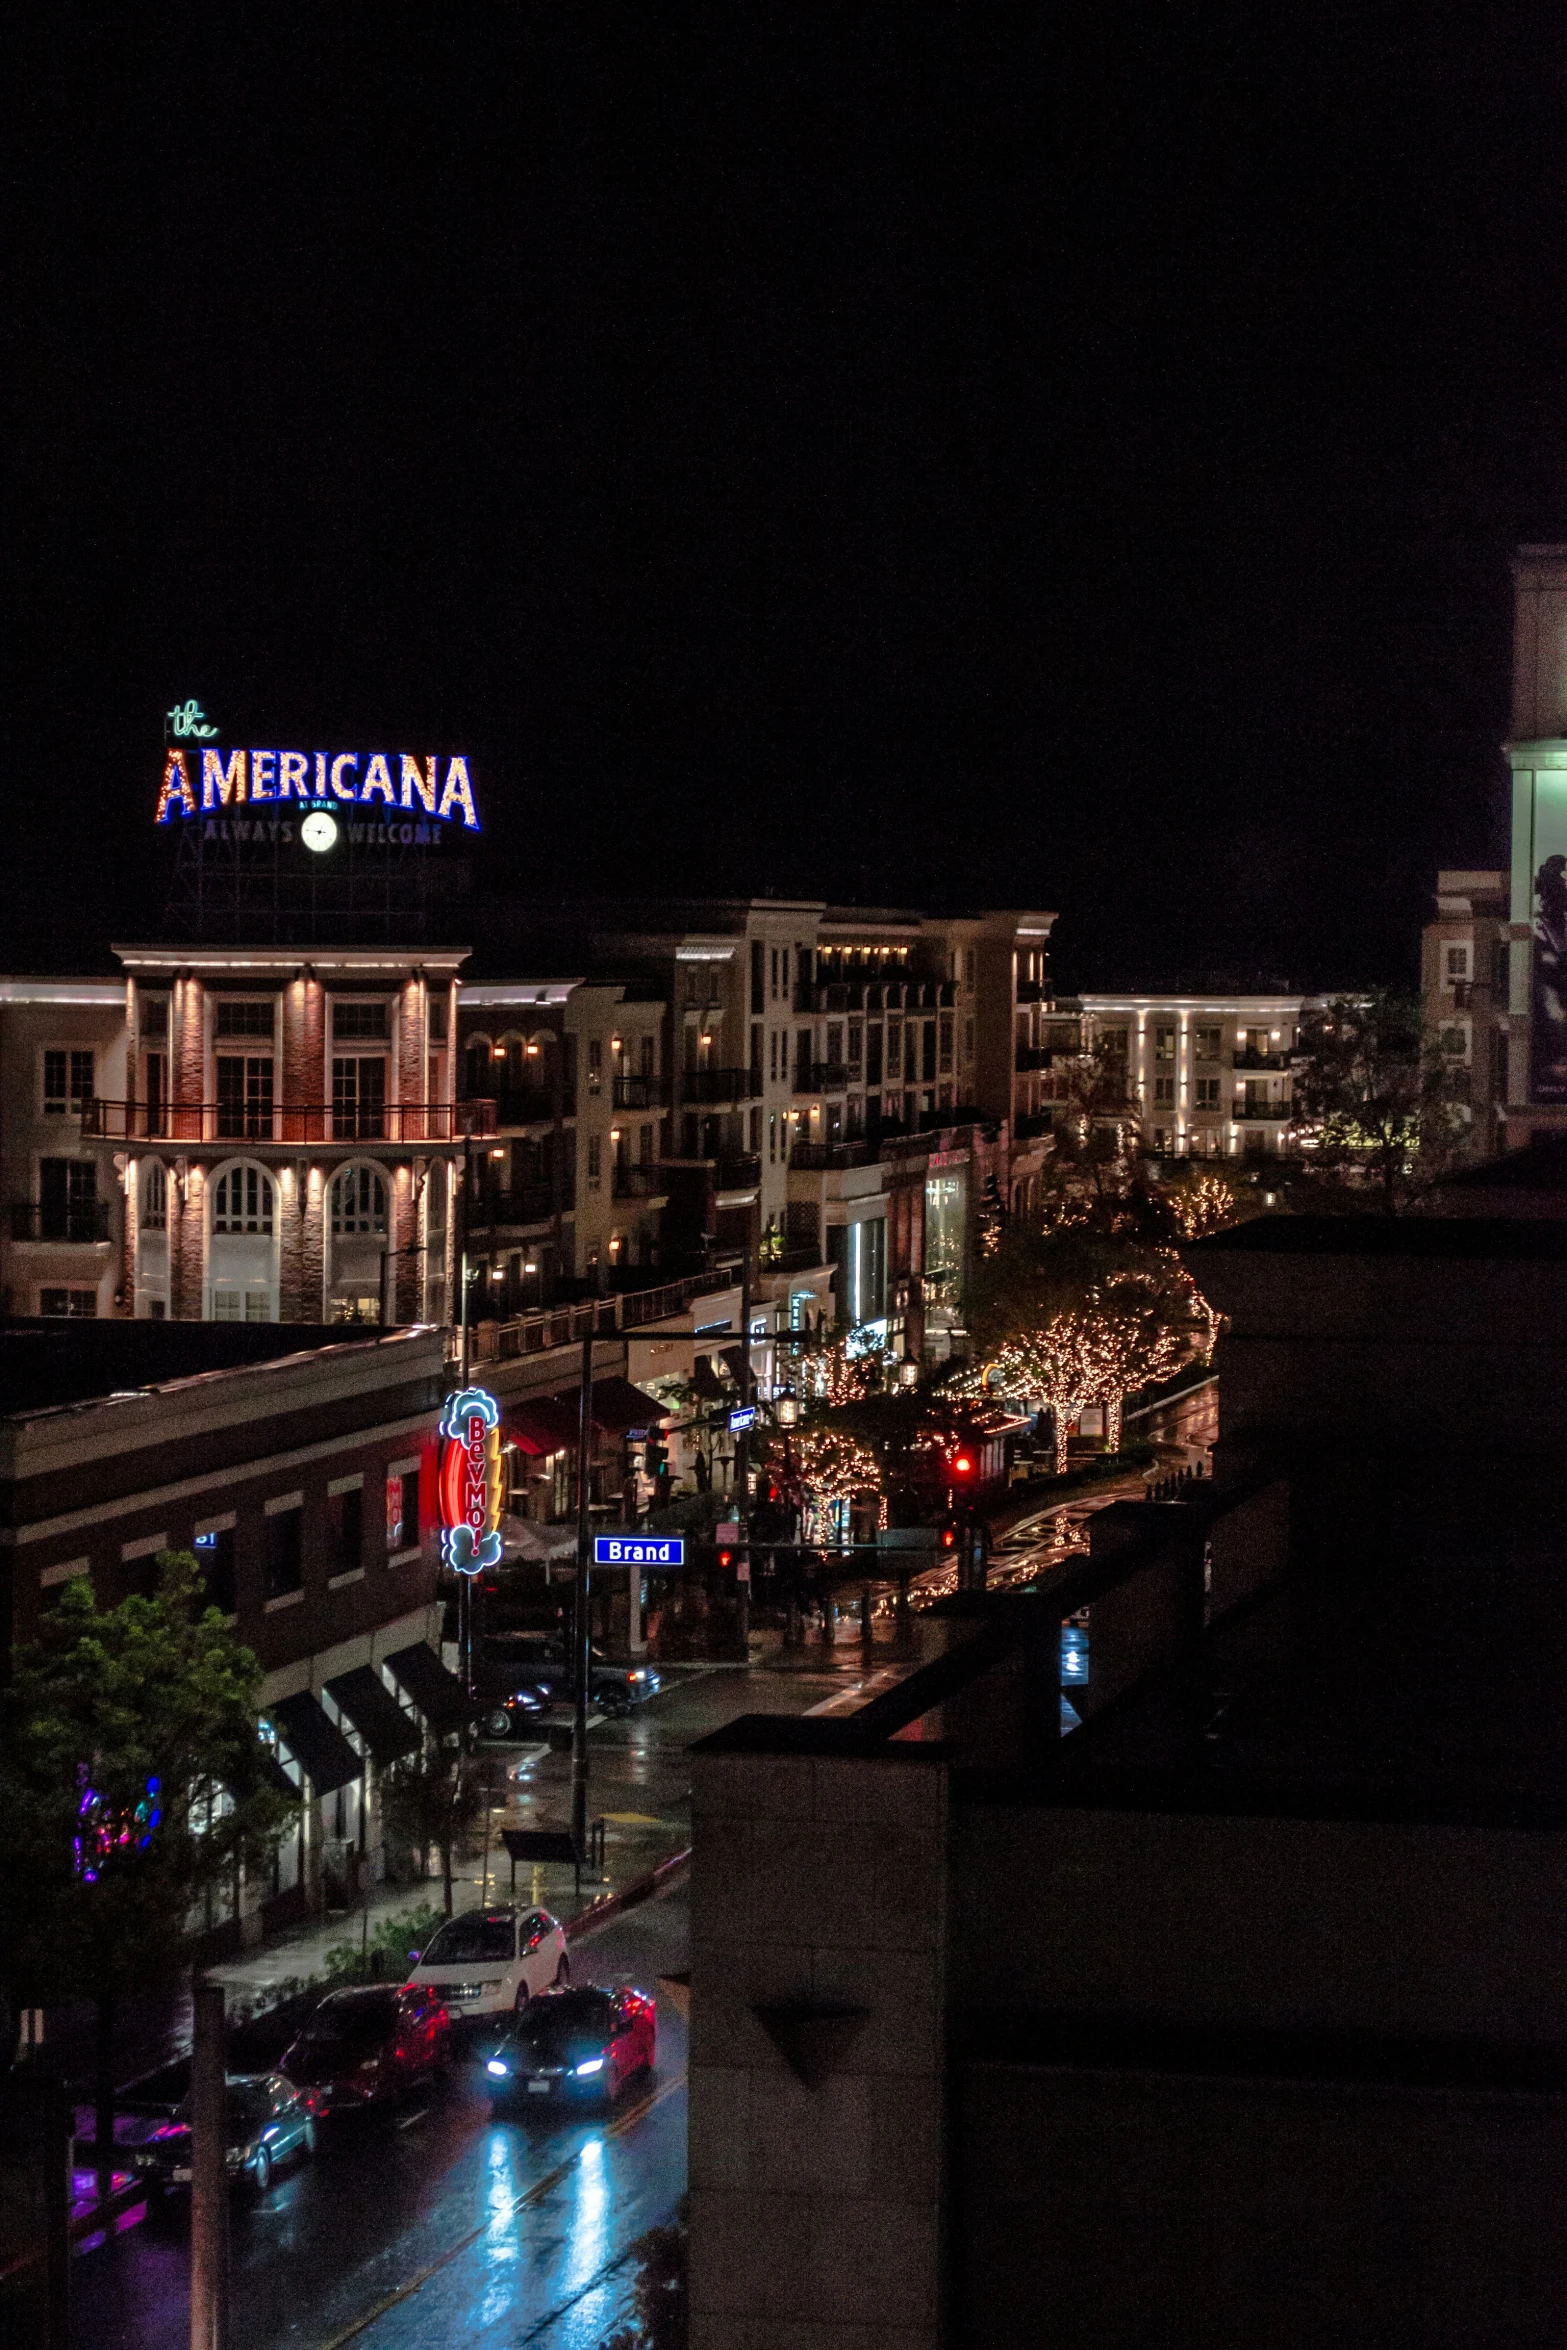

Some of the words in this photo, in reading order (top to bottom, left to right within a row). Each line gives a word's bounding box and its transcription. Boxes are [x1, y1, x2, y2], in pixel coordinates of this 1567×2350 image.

[167, 699, 220, 738] the
[153, 747, 482, 832] AMERICANA
[203, 818, 294, 843] ALWAYS
[346, 822, 442, 844] WELCOME
[608, 1541, 670, 1562] Brand
